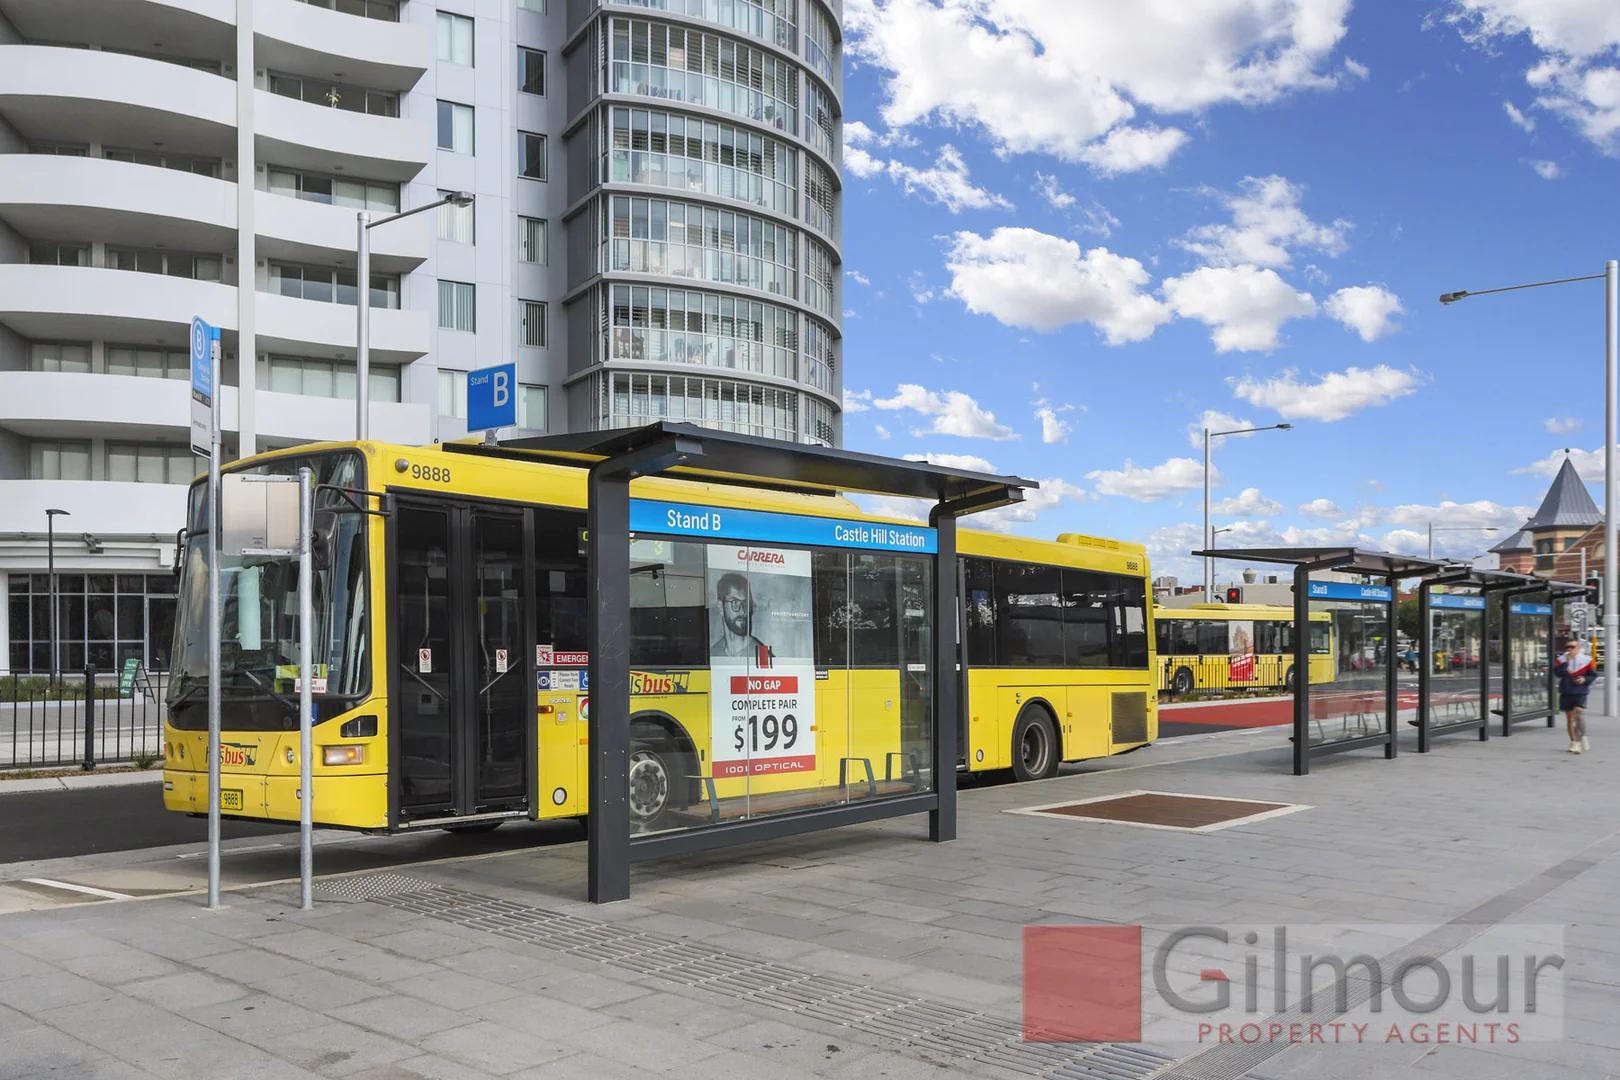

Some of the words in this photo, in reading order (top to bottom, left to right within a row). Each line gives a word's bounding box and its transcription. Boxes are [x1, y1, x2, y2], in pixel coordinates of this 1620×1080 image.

[470, 374, 489, 386] Stand
[493, 371, 509, 407] B
[411, 464, 451, 483] 9888
[667, 509, 709, 530] Stand
[712, 513, 721, 531] B
[835, 525, 869, 543] Castle
[870, 528, 888, 544] Hill
[889, 530, 925, 547] Station
[737, 549, 785, 564] CARRERA
[1126, 561, 1138, 571] 9888
[556, 654, 588, 663] EMERGE
[748, 680, 762, 690] NO
[763, 680, 781, 690] GAP
[731, 699, 776, 711] COMPLETE
[778, 699, 797, 709] PAIR
[734, 714, 798, 752] $199
[725, 766, 748, 774] 1001
[755, 762, 805, 771] OPTICAL
